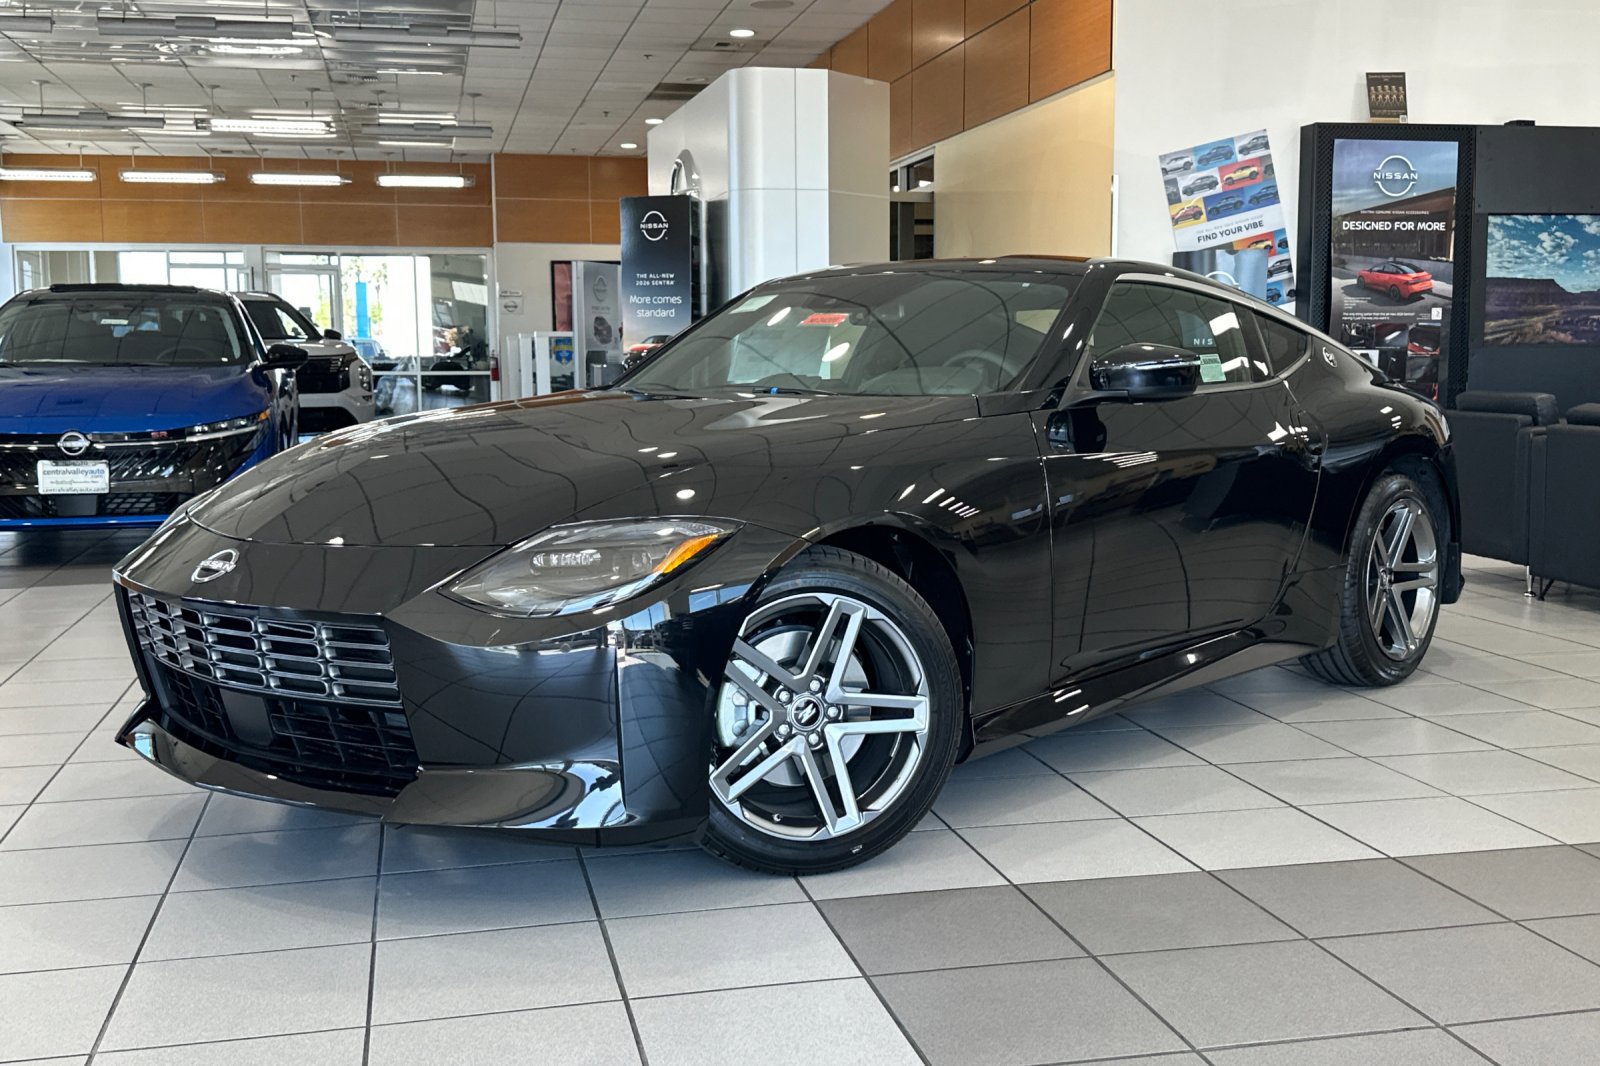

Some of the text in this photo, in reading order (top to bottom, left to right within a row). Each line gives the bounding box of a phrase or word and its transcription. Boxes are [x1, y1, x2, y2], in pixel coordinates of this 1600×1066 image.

[1373, 172, 1418, 180] NISSAN
[1342, 221, 1446, 231] DESIGNED FOR MORE
[1197, 232, 1218, 243] FIND
[1219, 226, 1243, 237] YOUR
[1244, 220, 1264, 231] VIBE
[630, 295, 682, 304] More comes
[636, 307, 675, 318] standard
[43, 467, 105, 477] centralvalleyauto
